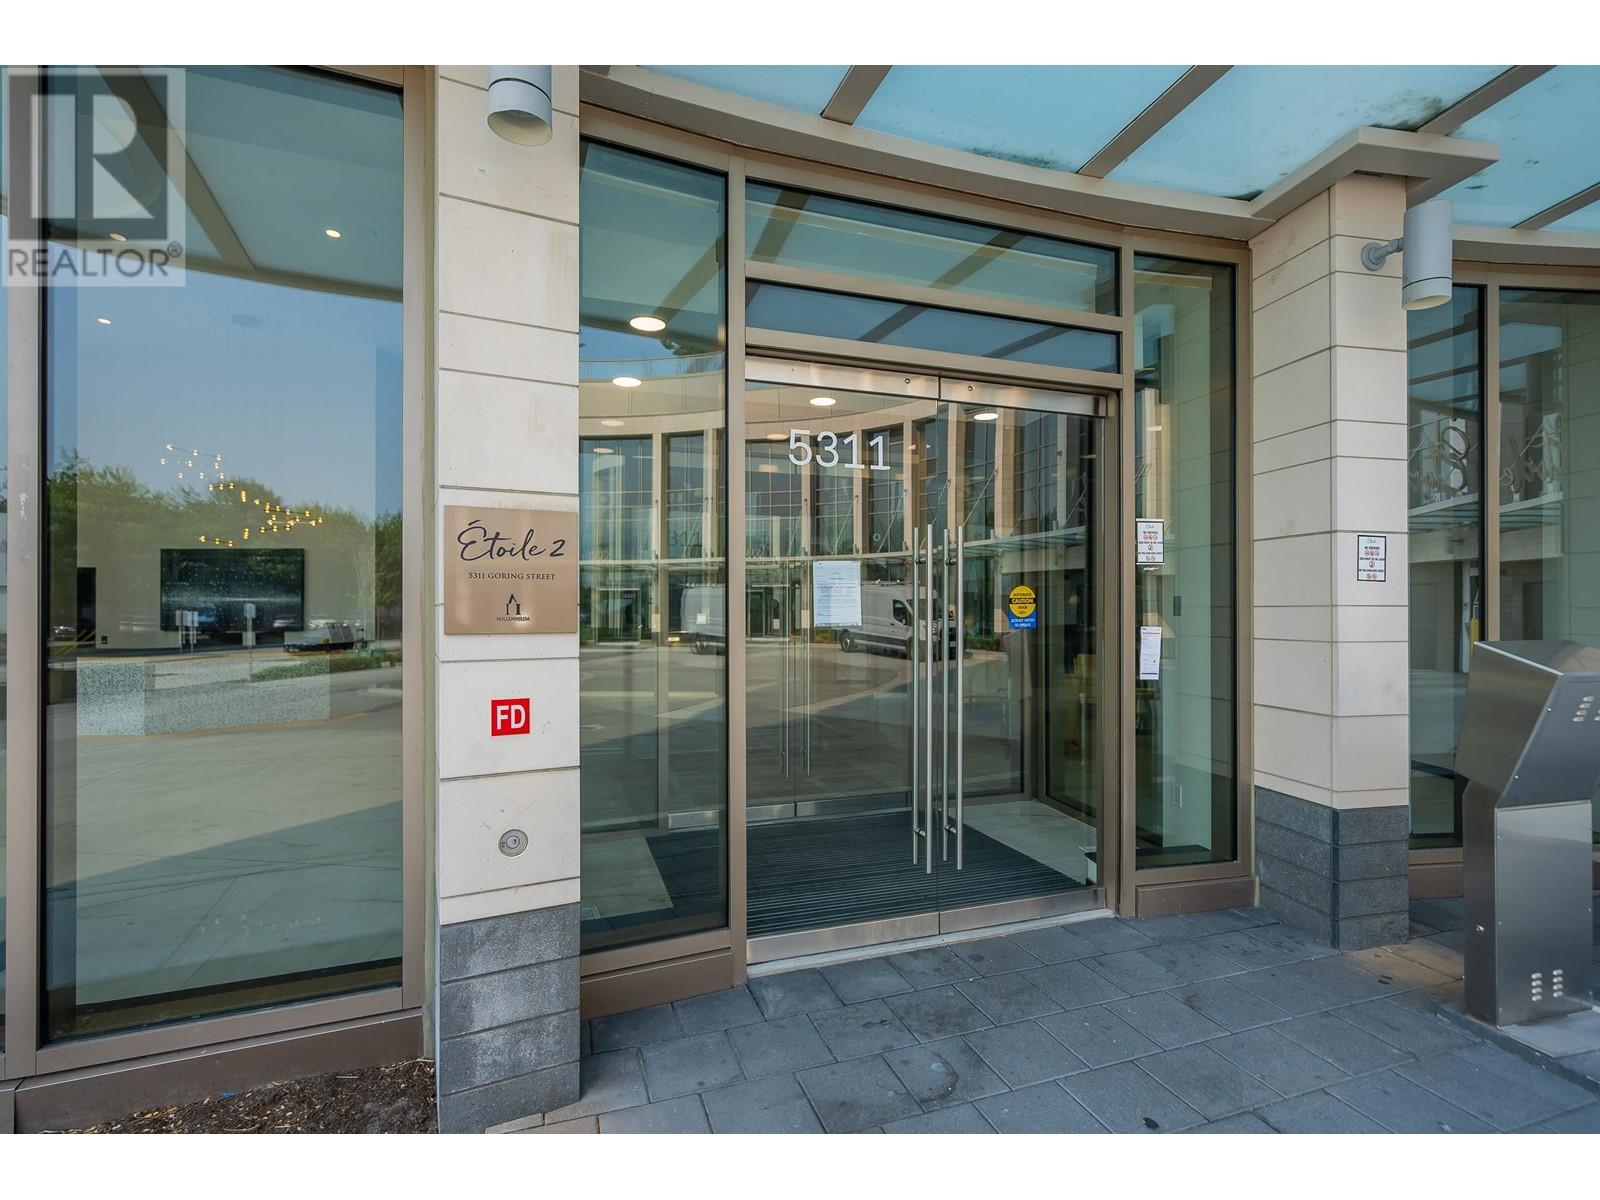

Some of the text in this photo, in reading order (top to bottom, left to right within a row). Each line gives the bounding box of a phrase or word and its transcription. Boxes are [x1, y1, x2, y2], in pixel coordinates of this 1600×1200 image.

[788, 428, 891, 470] 5311
[457, 519, 566, 561] Étoile 2
[468, 571, 485, 580] 5311
[488, 572, 524, 580] GORING
[496, 704, 526, 730] FD
